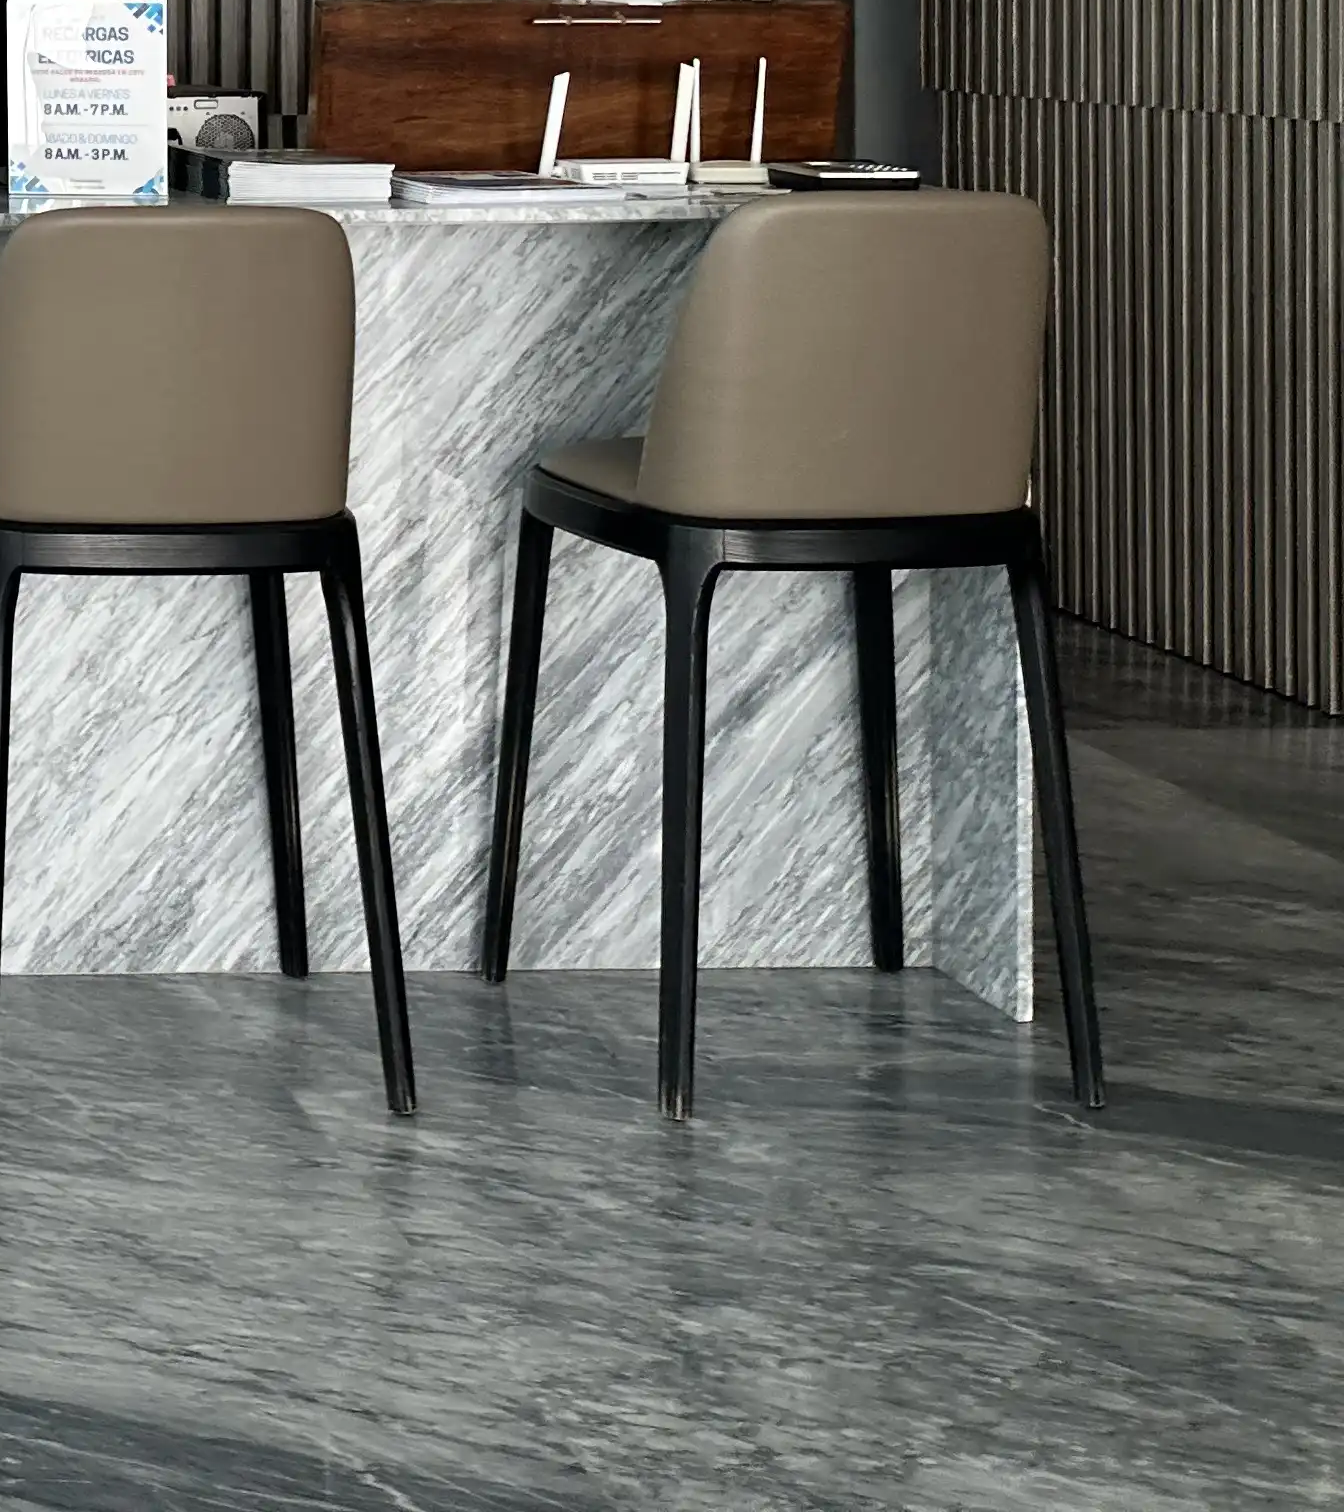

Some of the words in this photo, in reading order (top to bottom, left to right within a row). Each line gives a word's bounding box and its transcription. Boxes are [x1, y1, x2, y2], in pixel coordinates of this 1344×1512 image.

[43, 88, 76, 100] LUNES
[77, 88, 85, 100] A
[85, 88, 131, 100] VIERNES
[44, 103, 52, 116] 8
[54, 103, 81, 116] A.M.
[90, 103, 99, 116] 7
[100, 103, 129, 116] P.M.
[88, 133, 138, 145] DOMINGO
[44, 147, 53, 160] 8
[55, 148, 82, 160] A.M.
[91, 148, 99, 161] 3
[101, 148, 130, 161] P.M.
